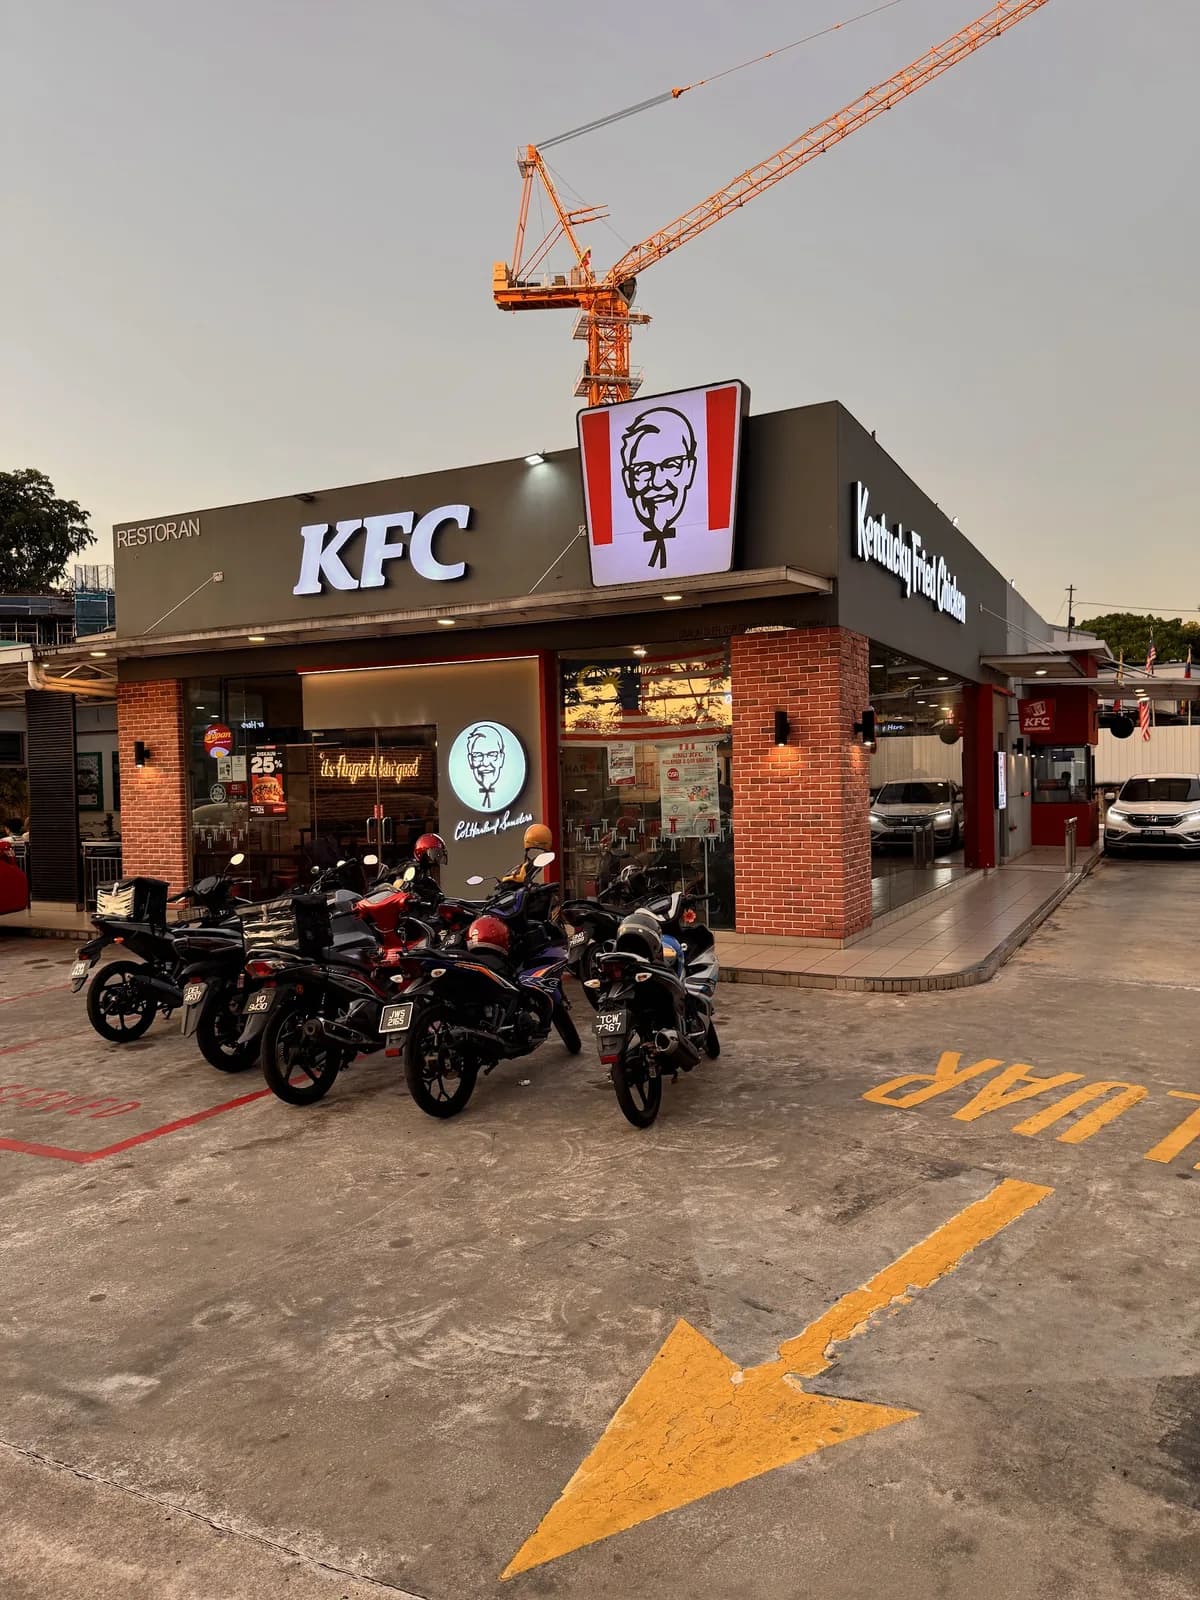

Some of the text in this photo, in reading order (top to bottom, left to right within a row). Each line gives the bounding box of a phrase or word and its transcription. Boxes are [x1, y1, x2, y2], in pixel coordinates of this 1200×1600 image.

[116, 517, 201, 549] RESTORAN
[293, 504, 471, 596] KFC
[857, 480, 966, 625] Kentucky Fried Chicken
[1023, 717, 1051, 727] KFC
[387, 1017, 404, 1027] 2165
[390, 1009, 406, 1019] JWS
[600, 1013, 620, 1025] TCW
[861, 1050, 1200, 1171] LUAR
